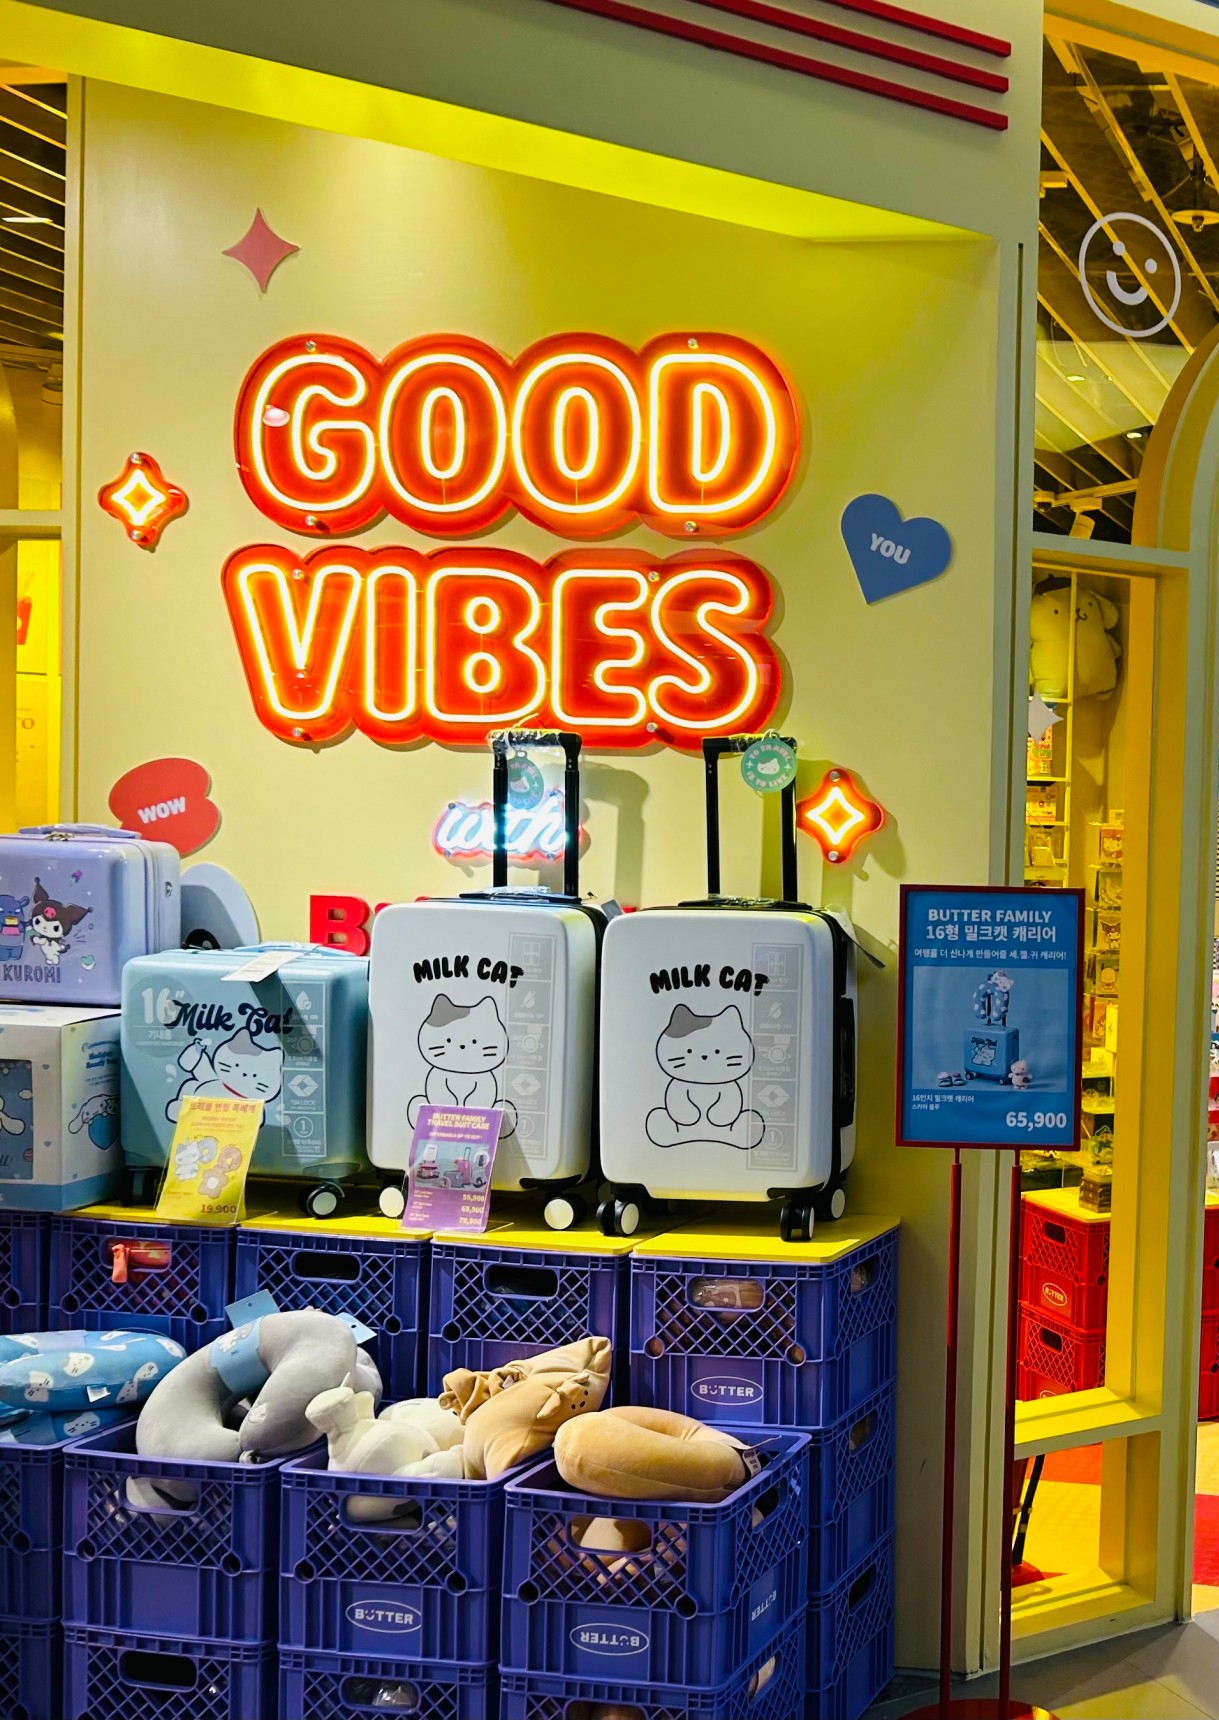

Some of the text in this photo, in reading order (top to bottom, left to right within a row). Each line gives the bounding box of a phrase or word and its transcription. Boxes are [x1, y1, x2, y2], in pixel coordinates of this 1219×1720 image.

[245, 345, 785, 520] GOOD
[870, 532, 911, 565] YOU
[230, 555, 765, 735] VIBES
[137, 796, 186, 824] WOW
[928, 908, 1052, 923] BUTTER FAMILY
[926, 924, 1056, 943] 16형 밀크캣 캐리어
[914, 948, 938, 958] 여행을
[939, 949, 948, 959] 더
[950, 949, 974, 959] 신나게
[975, 950, 1007, 959] 만들어줄
[3, 964, 61, 984] KUROMI
[413, 955, 525, 989] MILK CAT
[650, 963, 771, 996] MILK CAT
[165, 998, 294, 1037] Milk Cat
[1005, 1111, 1067, 1132] 65,900
[200, 1204, 237, 1214] 19,900
[699, 1384, 754, 1398] BUTTER
[354, 1608, 414, 1625] BUTTER
